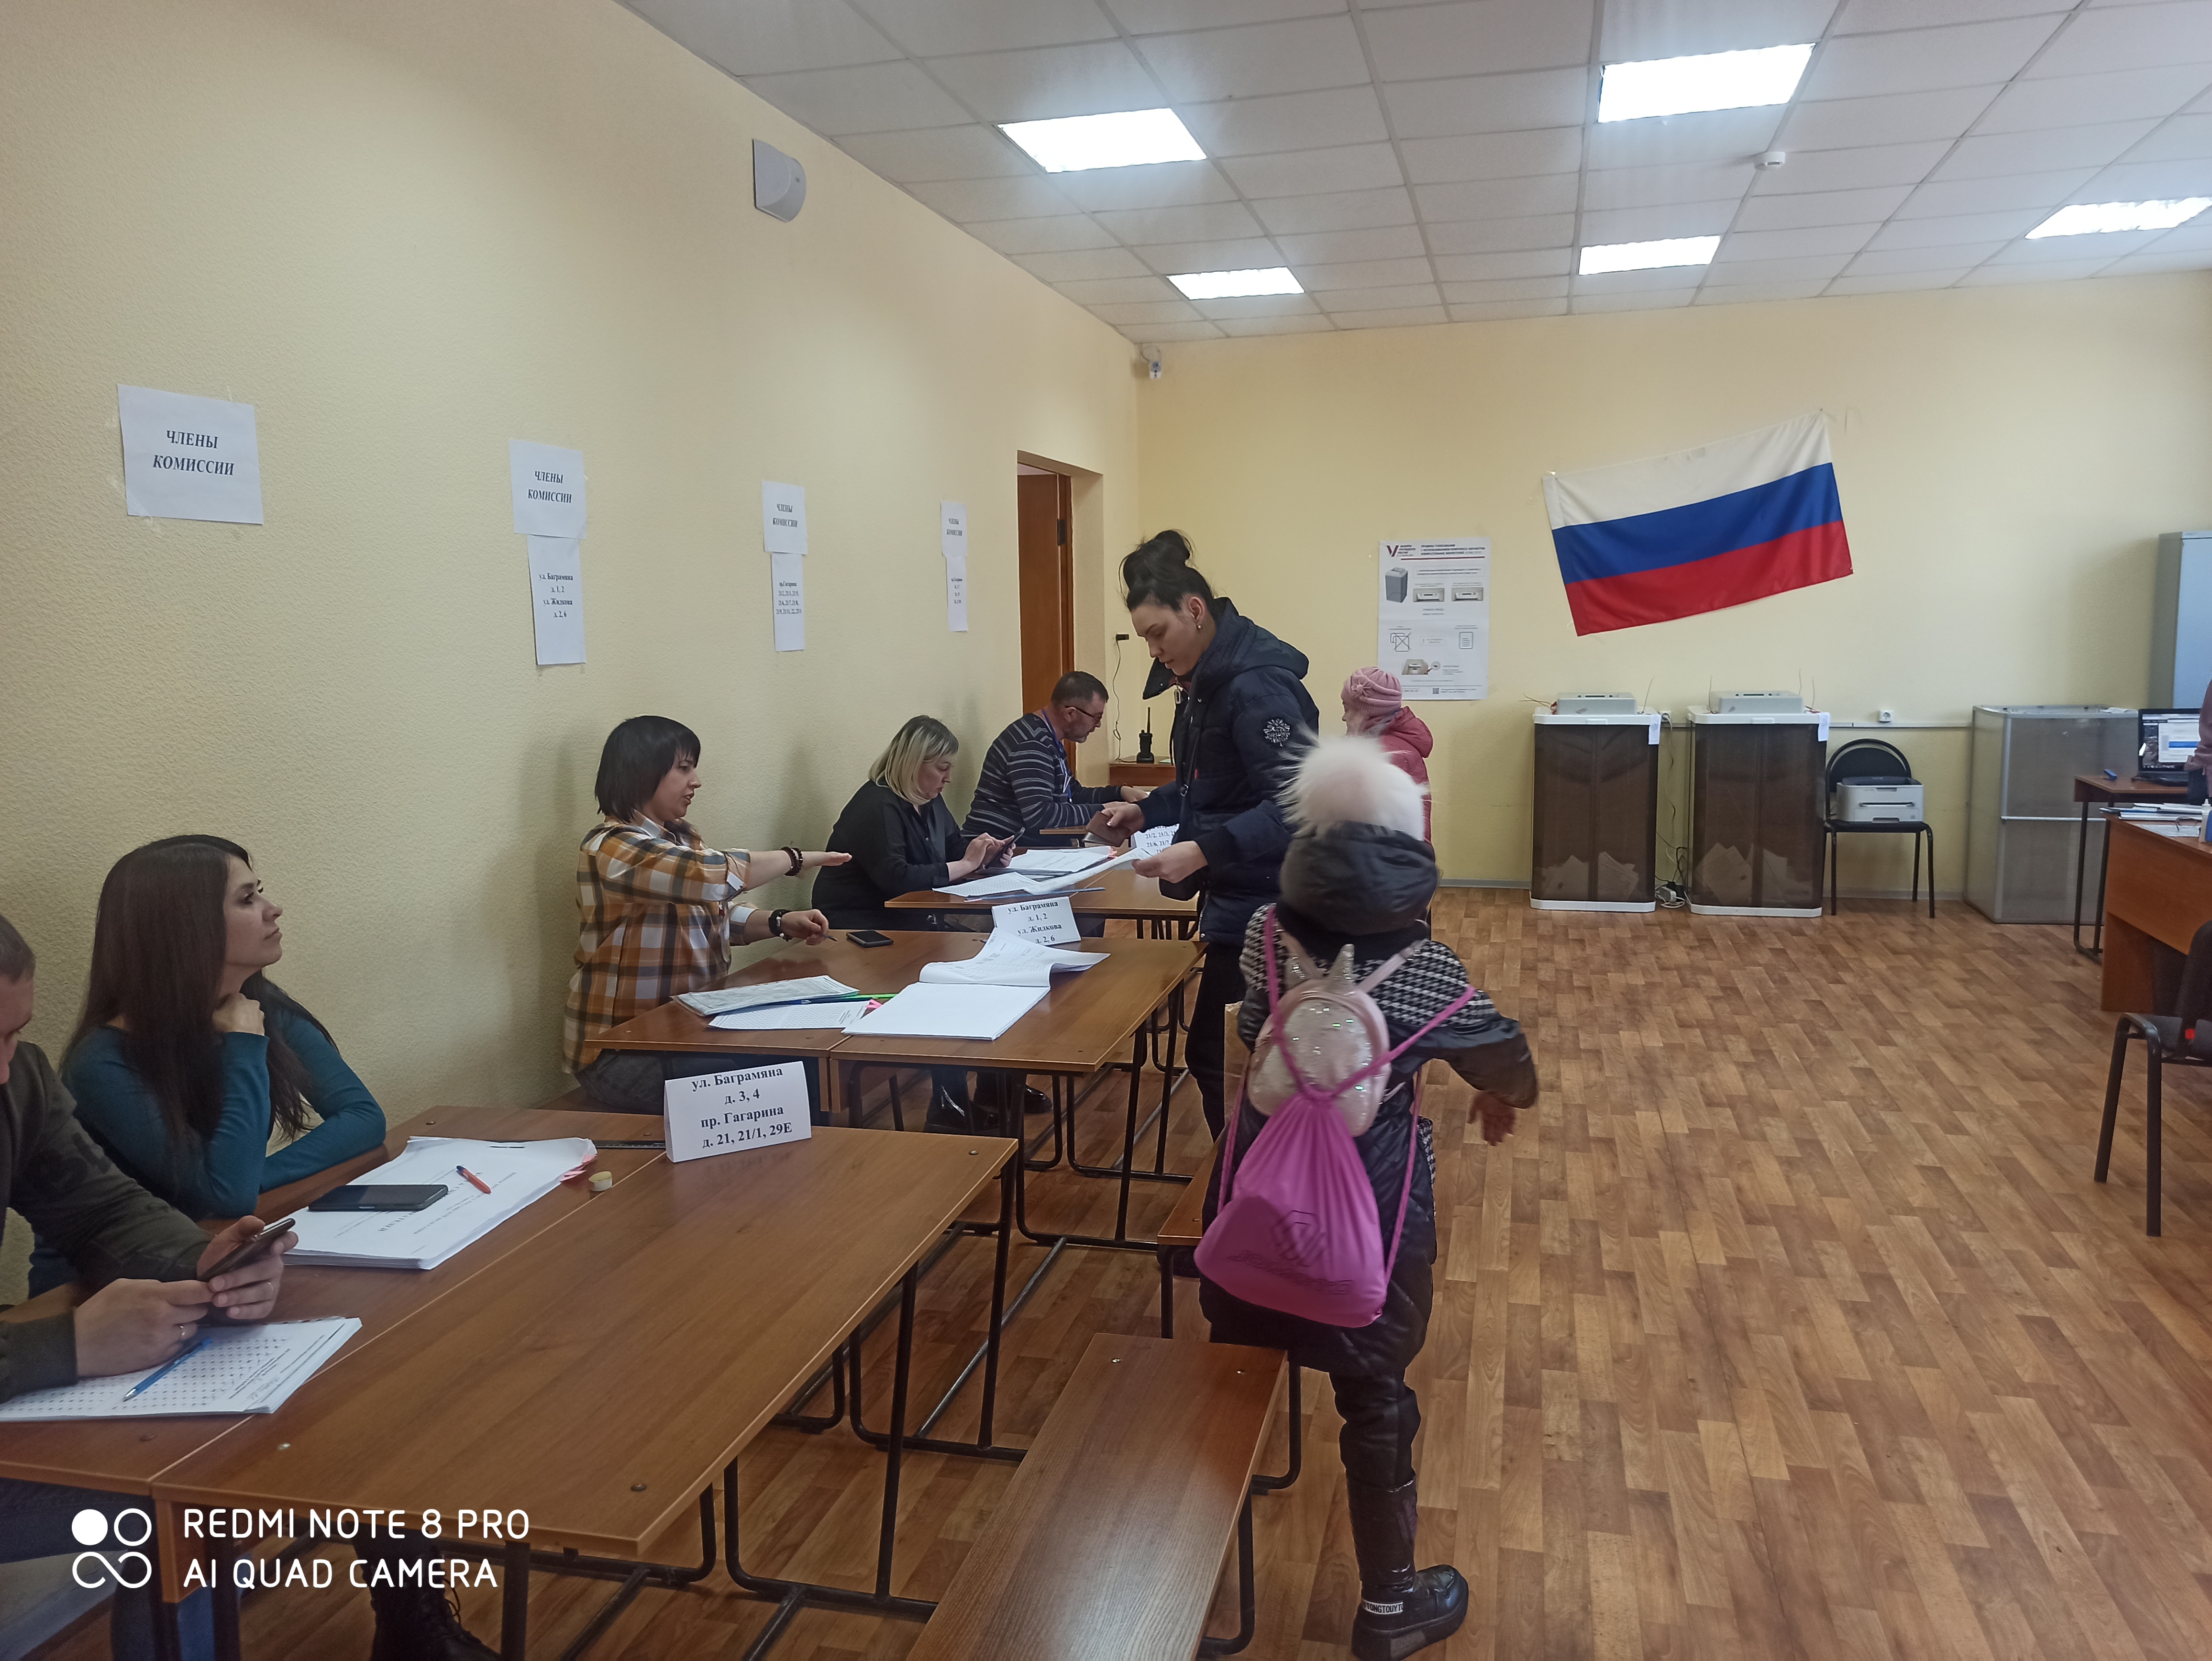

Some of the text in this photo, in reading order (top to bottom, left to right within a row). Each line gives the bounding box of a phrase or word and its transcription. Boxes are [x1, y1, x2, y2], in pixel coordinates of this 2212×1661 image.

[166, 430, 219, 449] ЧЛЕНЫ
[153, 454, 234, 476] КОМИССИИ
[535, 470, 563, 483] ЧЛЕНЫ
[528, 489, 572, 503] КОМИССИИ
[1020, 901, 1058, 911] Баграмяна
[691, 1068, 783, 1092] ул. Баграмяна
[724, 1088, 760, 1105] д. 3, 4
[701, 1106, 784, 1129] пр. Гагарина
[702, 1122, 792, 1148] д. 21, 21/1, 29Е
